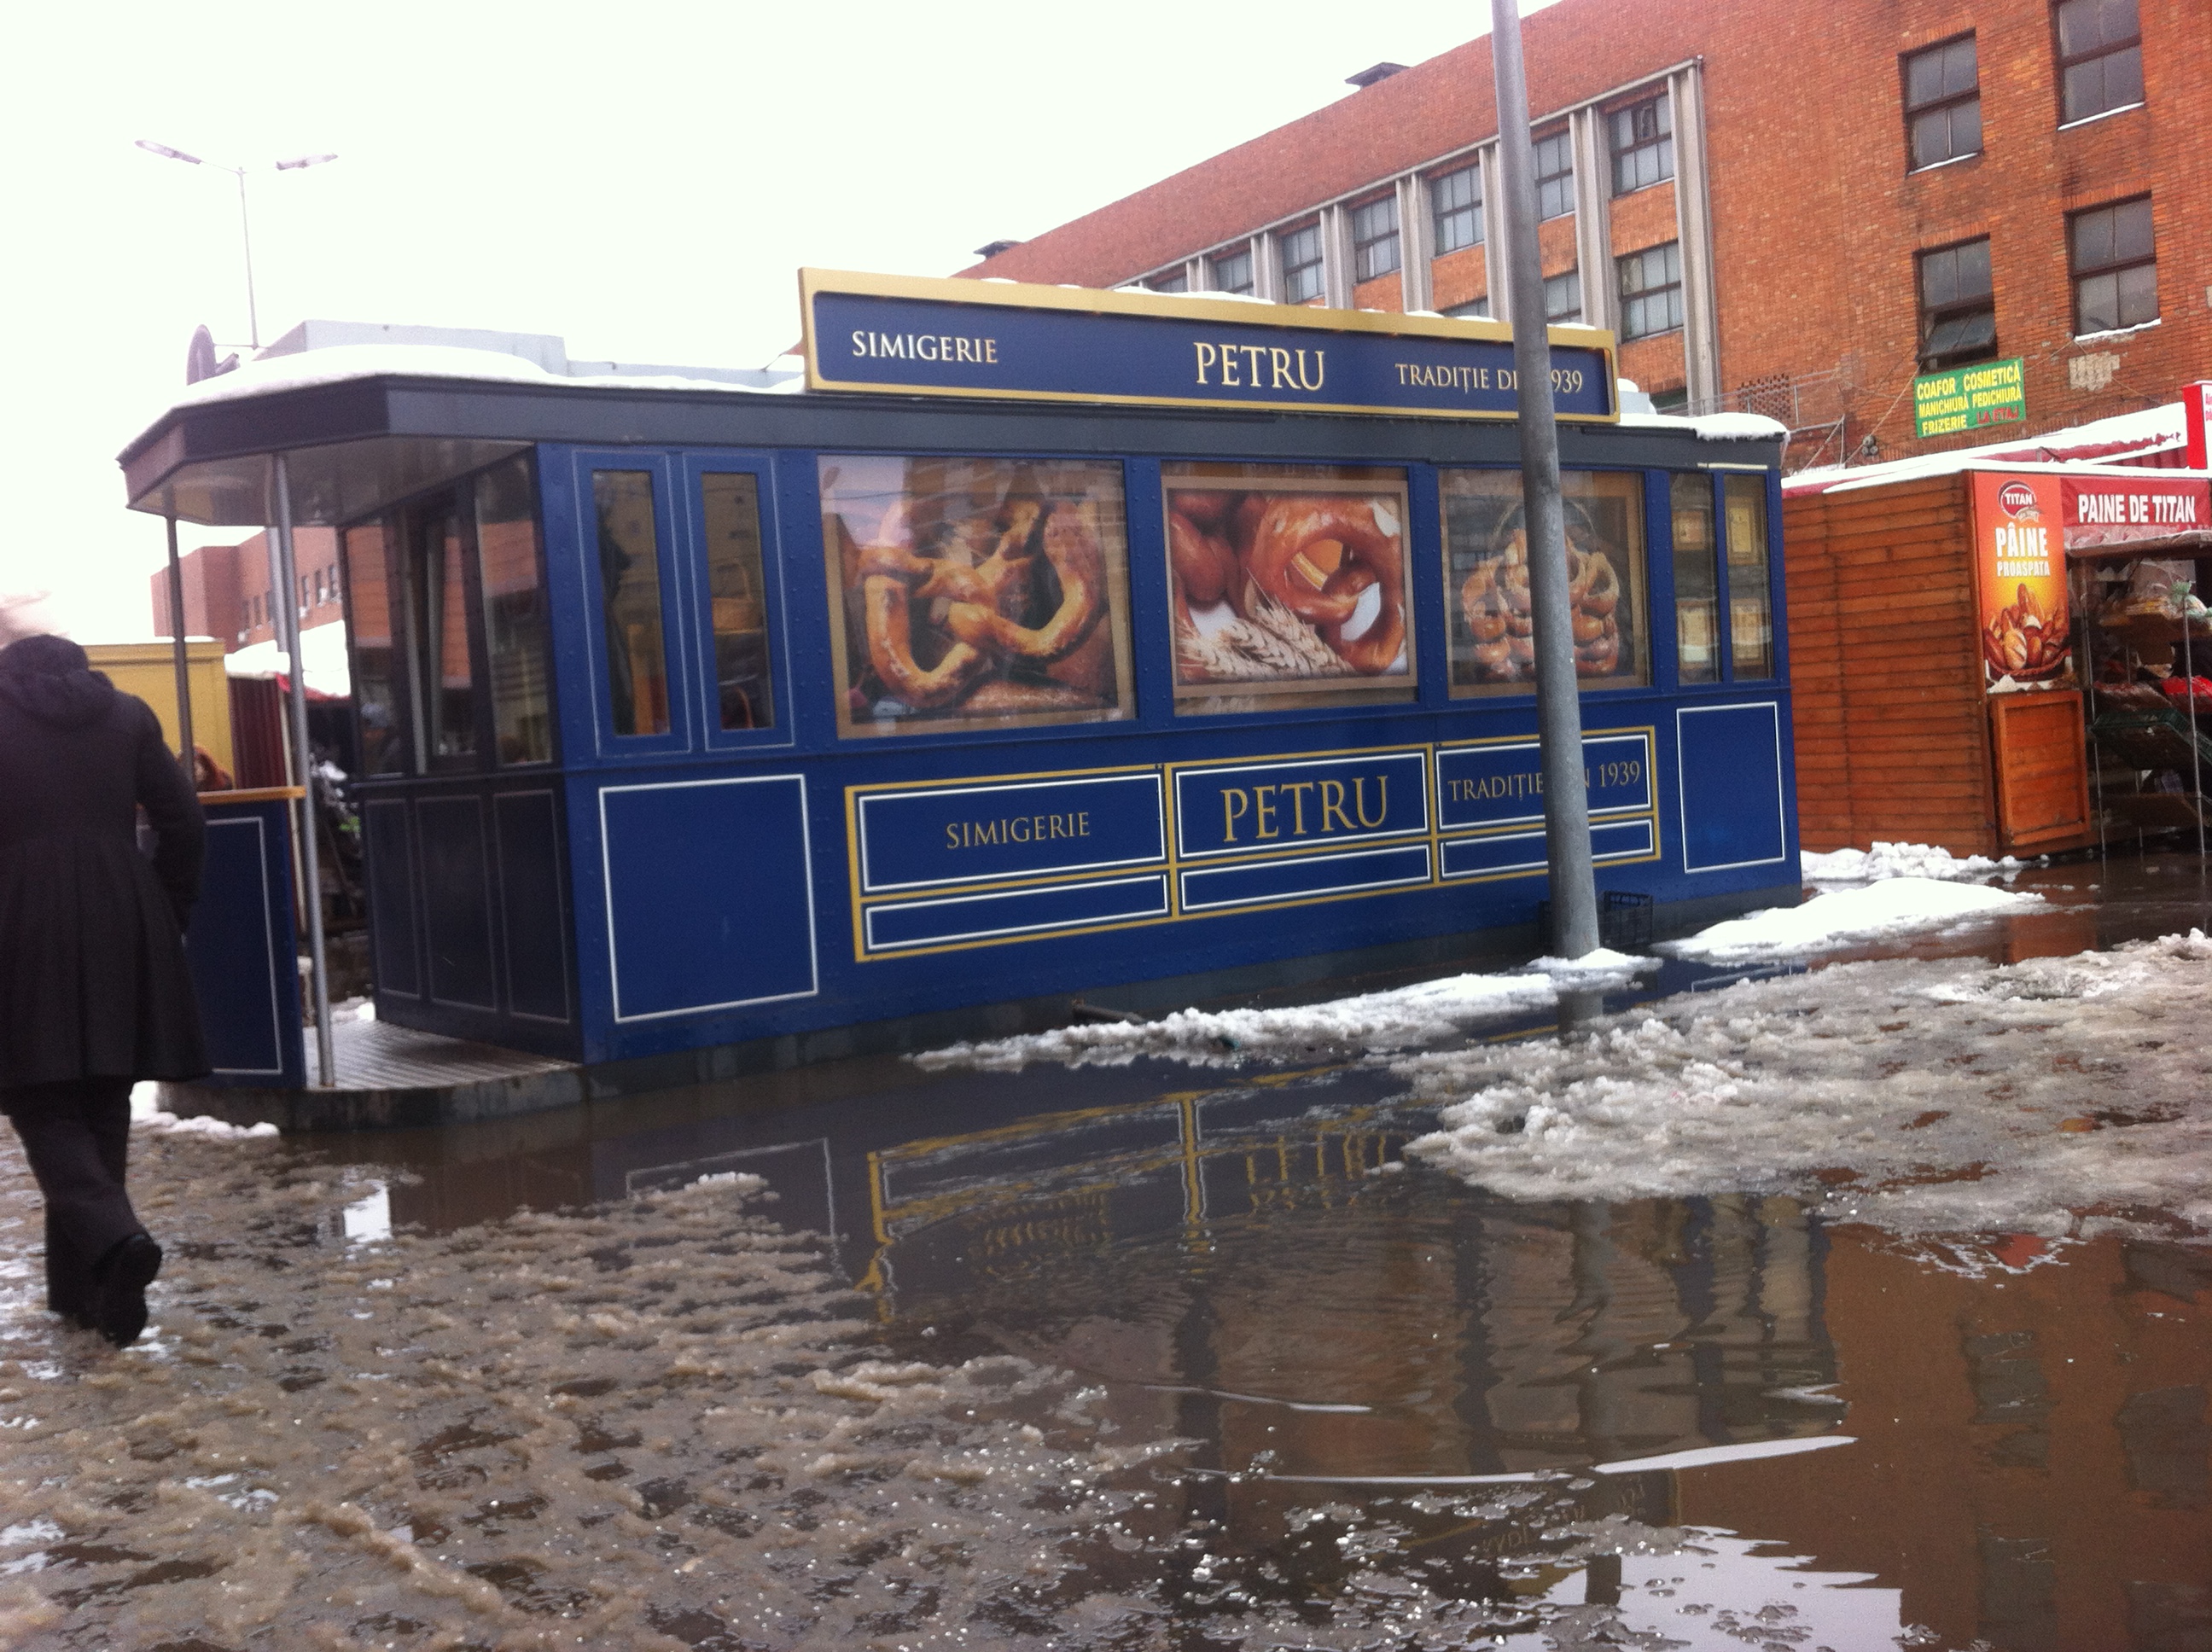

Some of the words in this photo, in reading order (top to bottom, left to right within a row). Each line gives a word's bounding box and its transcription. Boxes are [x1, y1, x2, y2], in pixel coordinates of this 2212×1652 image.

[853, 330, 998, 363] SIMIGERIE
[1193, 342, 1324, 391] PETRU
[1497, 369, 1517, 390] DI
[1551, 369, 1582, 393] 939
[1917, 377, 1956, 400] COAFOR
[1922, 415, 1967, 436] FRIZERIE
[1976, 410, 1990, 425] LA
[2005, 493, 2032, 505] TITAN
[2078, 494, 2126, 523] PAINE
[2129, 494, 2149, 523] DE
[2151, 495, 2196, 522] TITAN
[1995, 521, 2048, 557] PÂINE
[946, 811, 1090, 849] SIMIGERIE
[1220, 776, 1388, 842] PETRU
[1599, 760, 1640, 788] 1939
